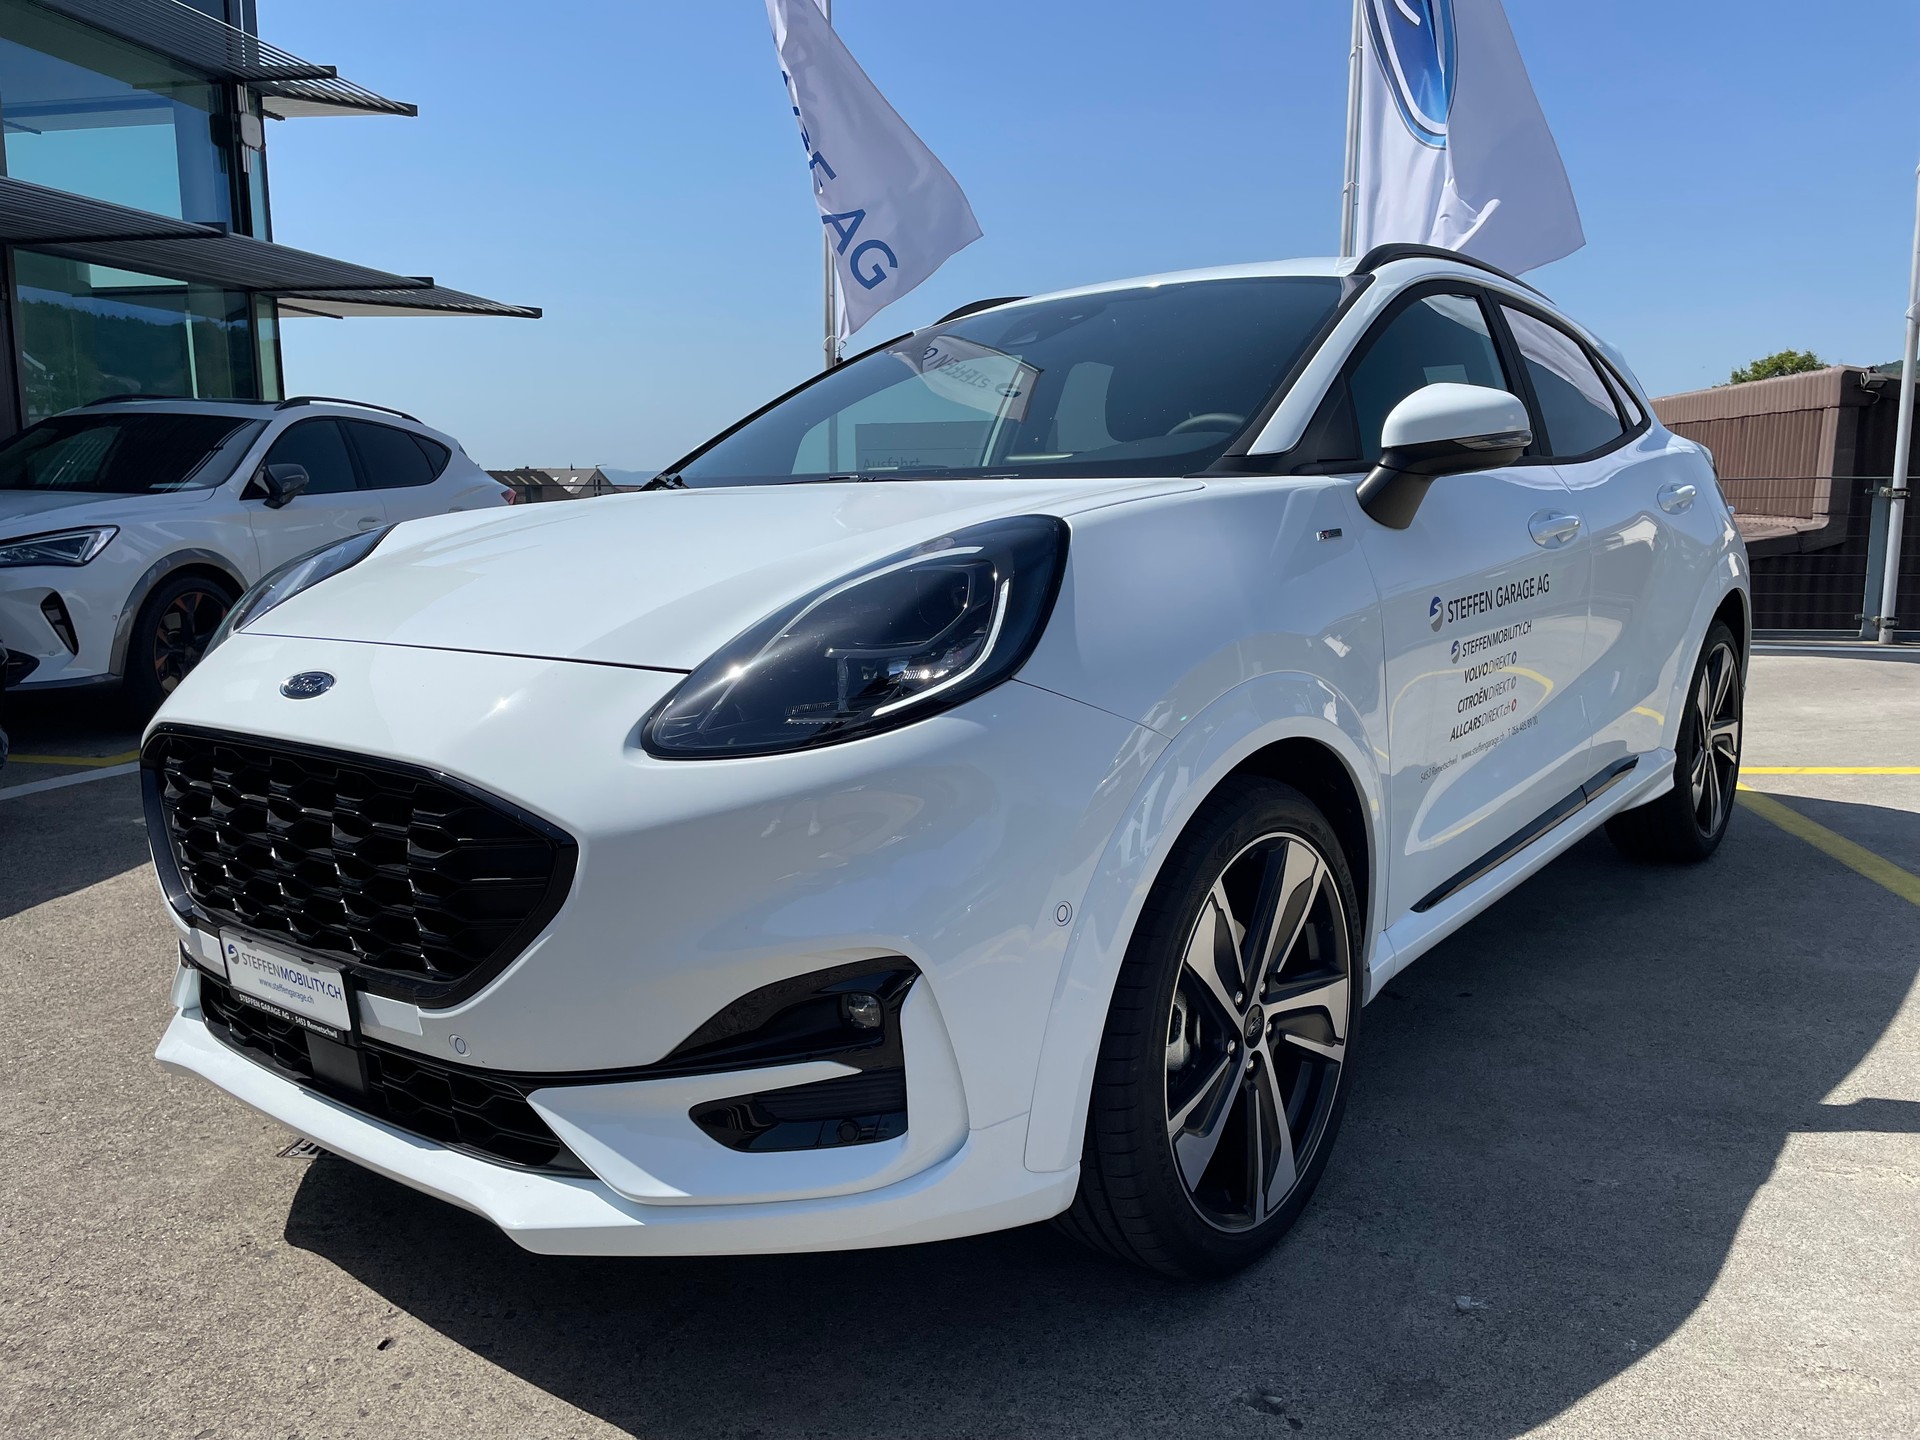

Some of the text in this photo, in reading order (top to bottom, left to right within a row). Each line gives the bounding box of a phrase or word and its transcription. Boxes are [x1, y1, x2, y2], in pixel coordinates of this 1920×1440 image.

[821, 208, 898, 290] AG
[1447, 573, 1549, 623] STEFFEN GARAGE AG
[1462, 620, 1532, 657] STEFFENMOBILITY.CH
[241, 952, 343, 1001] STEFFENMOBILITY.CH
[258, 978, 315, 1004] www.steffengarage.ch
[239, 993, 261, 1010] STEFFEN
[260, 1001, 281, 1017] GARAGE
[282, 1010, 290, 1020] AG
